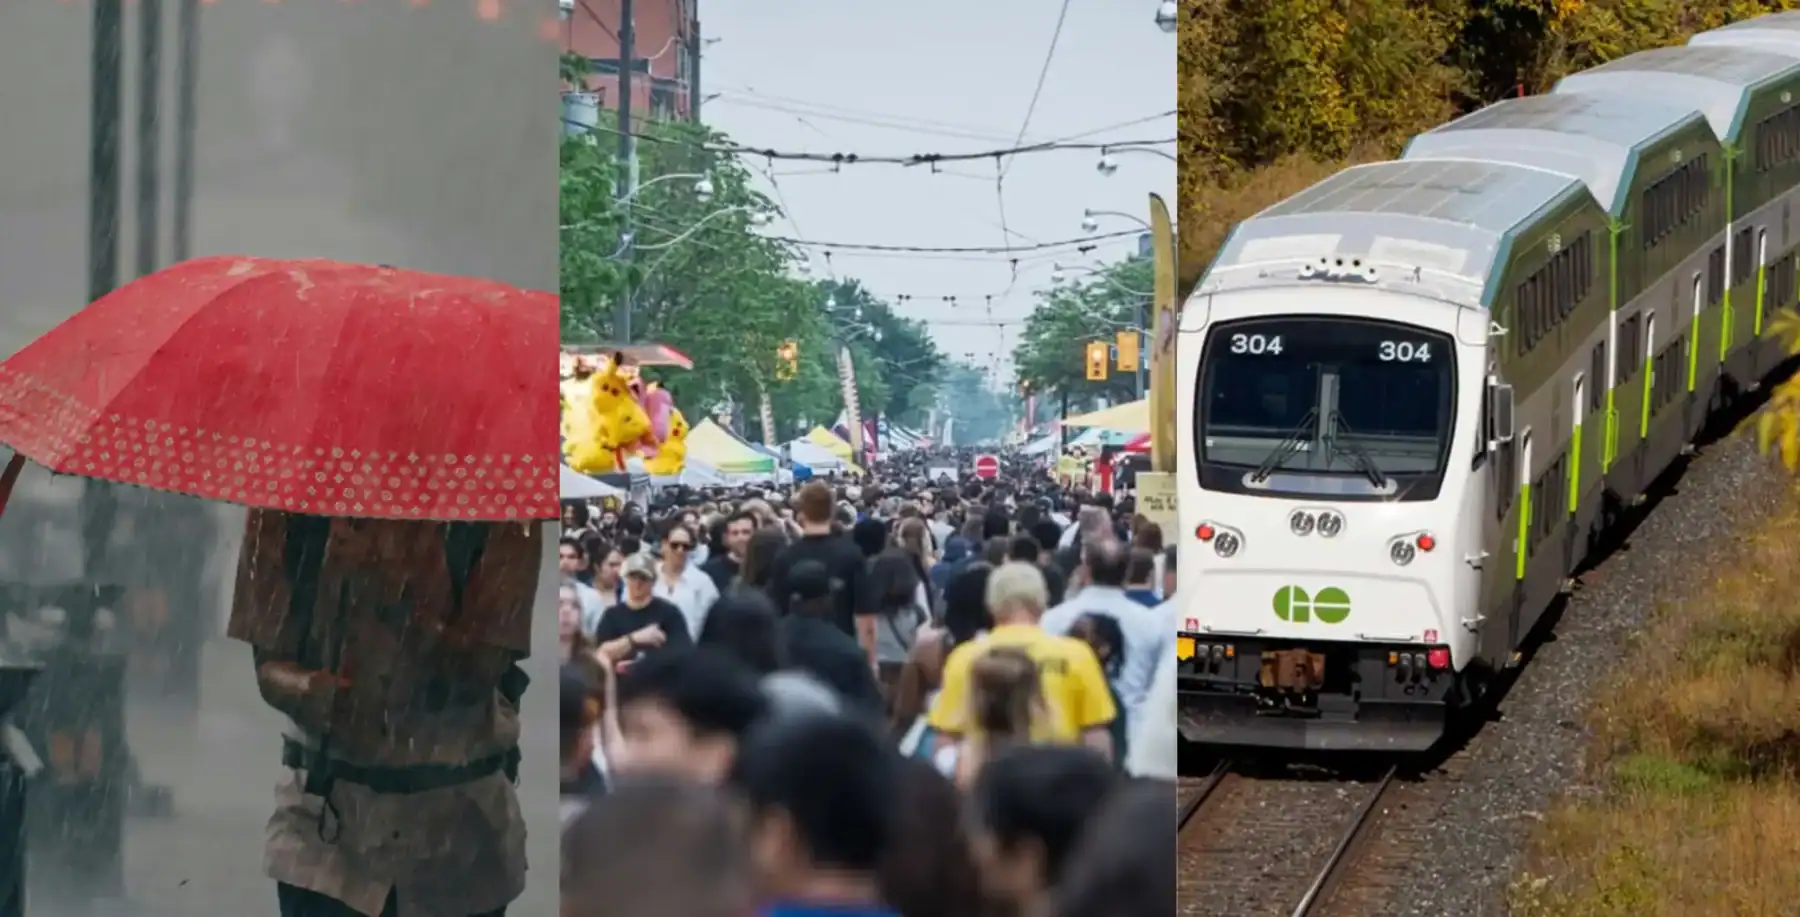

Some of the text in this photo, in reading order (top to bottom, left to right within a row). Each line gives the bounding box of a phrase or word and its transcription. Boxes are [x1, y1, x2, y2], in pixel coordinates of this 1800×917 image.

[1231, 334, 1283, 355] 304
[1379, 341, 1430, 362] 304
[1272, 585, 1350, 624] GO
